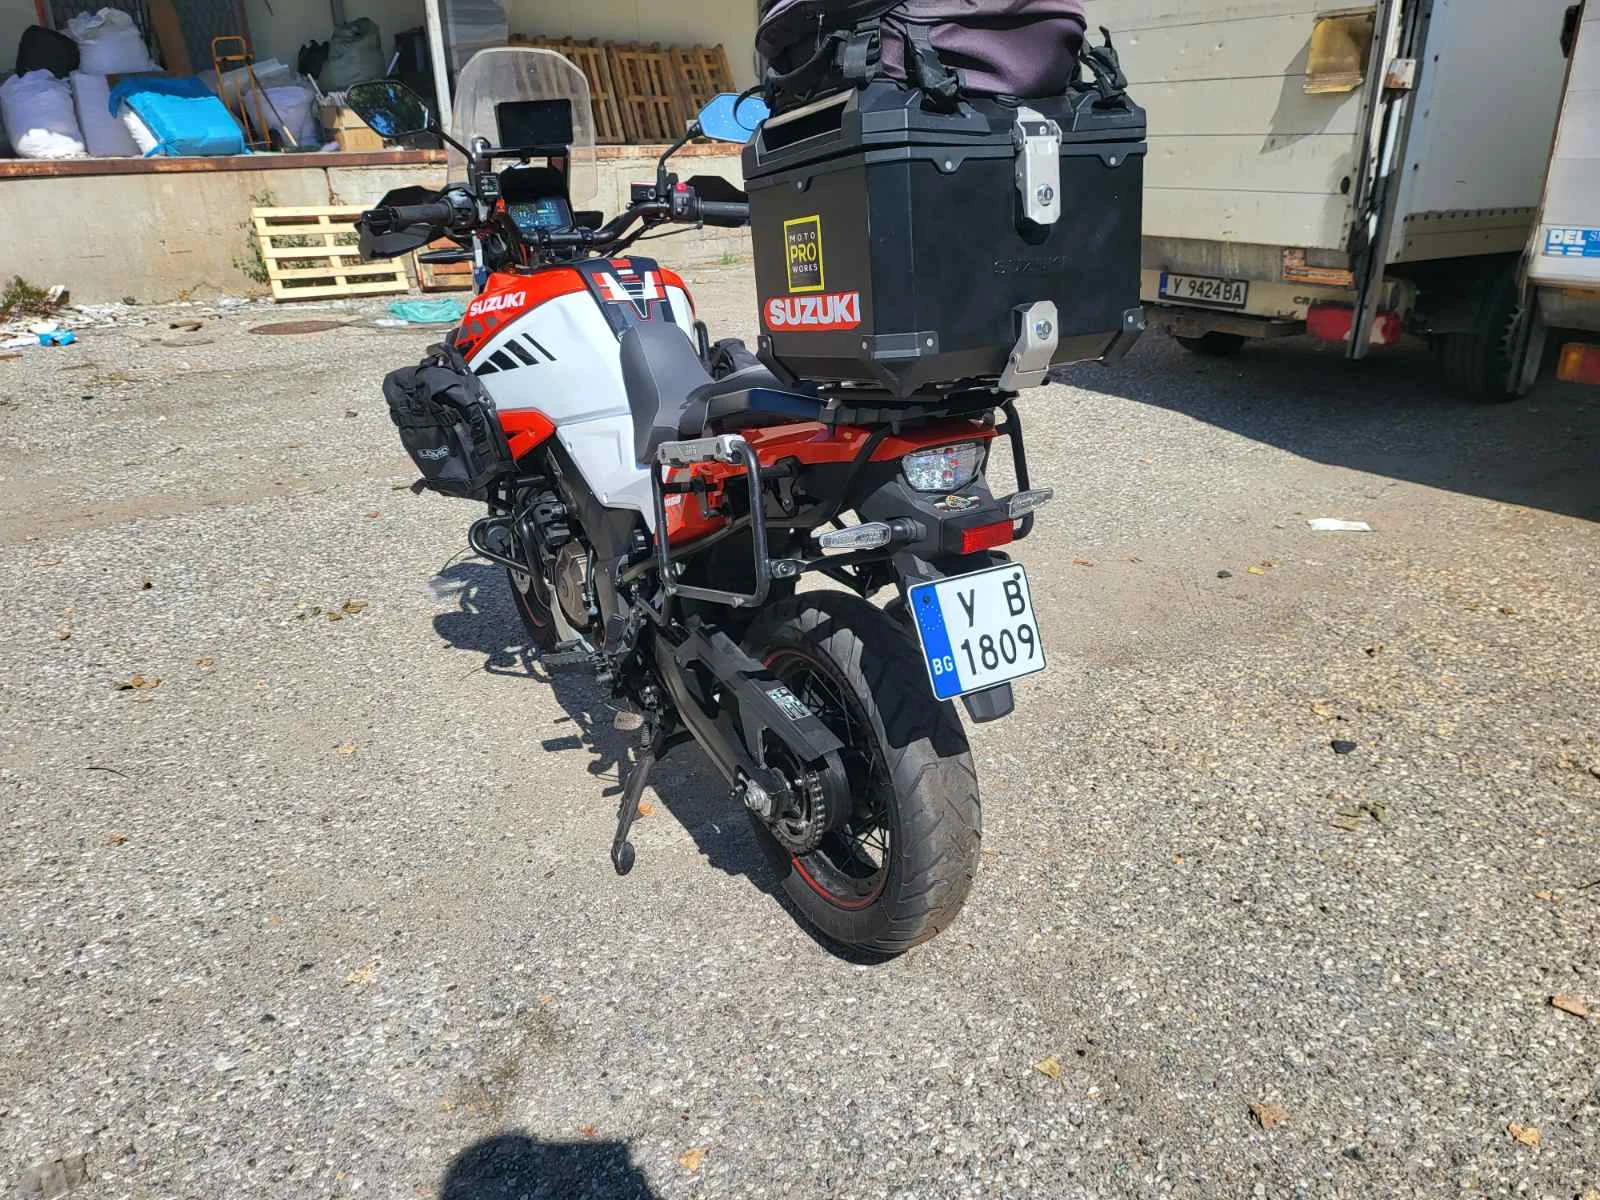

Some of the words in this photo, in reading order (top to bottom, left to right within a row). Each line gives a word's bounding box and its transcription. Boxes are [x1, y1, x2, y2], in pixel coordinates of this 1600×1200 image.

[789, 231, 816, 242] MOTO
[1549, 229, 1586, 245] DEL
[790, 242, 817, 263] PRO
[792, 263, 818, 273] WORKS
[1174, 277, 1183, 294] Y
[469, 291, 527, 316] SUZUKI
[769, 293, 861, 325] SUZUKI
[957, 589, 975, 627] Y
[1003, 580, 1026, 616] B
[961, 623, 1035, 676] 1809
[932, 656, 953, 675] BG
